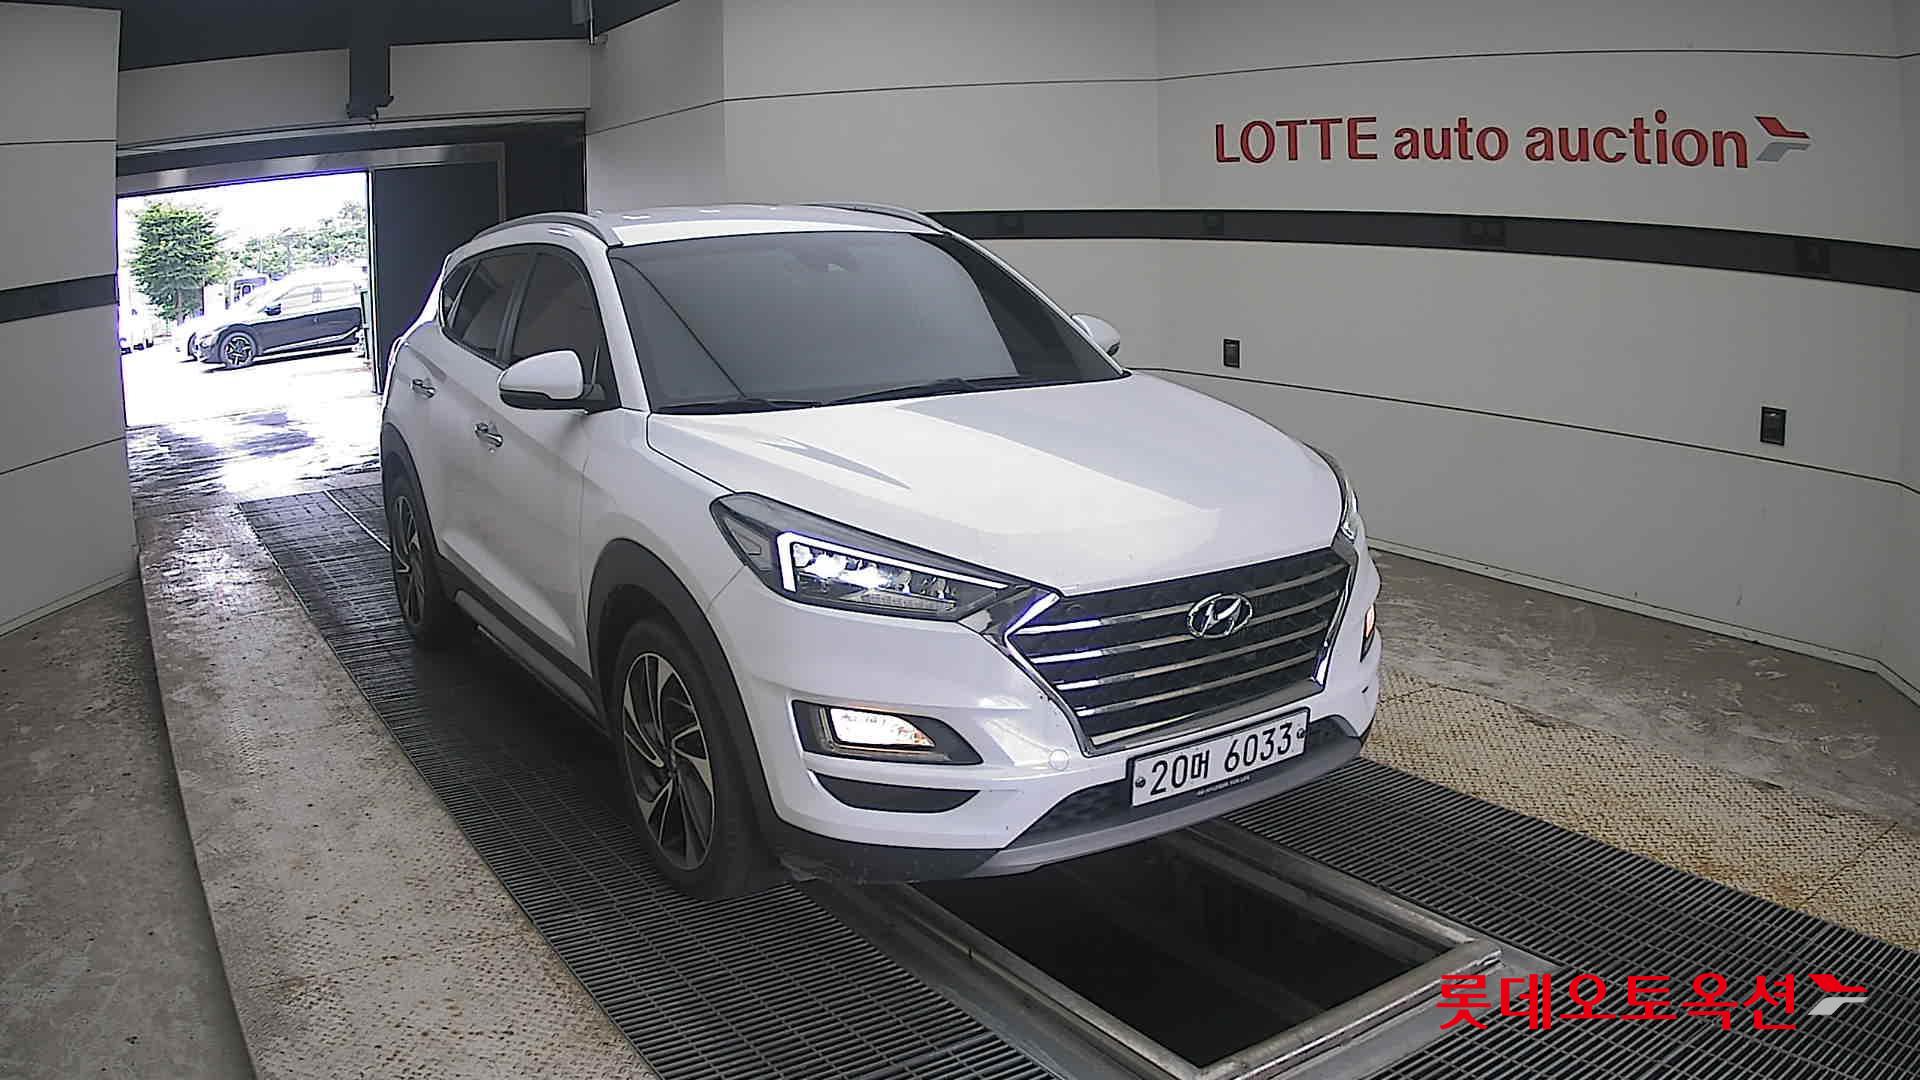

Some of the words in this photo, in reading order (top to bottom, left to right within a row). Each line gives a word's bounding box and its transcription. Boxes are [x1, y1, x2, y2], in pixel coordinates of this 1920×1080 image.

[1215, 116, 1378, 163] LOTTE
[1393, 117, 1509, 161] auto
[1525, 109, 1749, 168] auction
[1150, 748, 1210, 796] 20머
[1224, 721, 1293, 772] 6033
